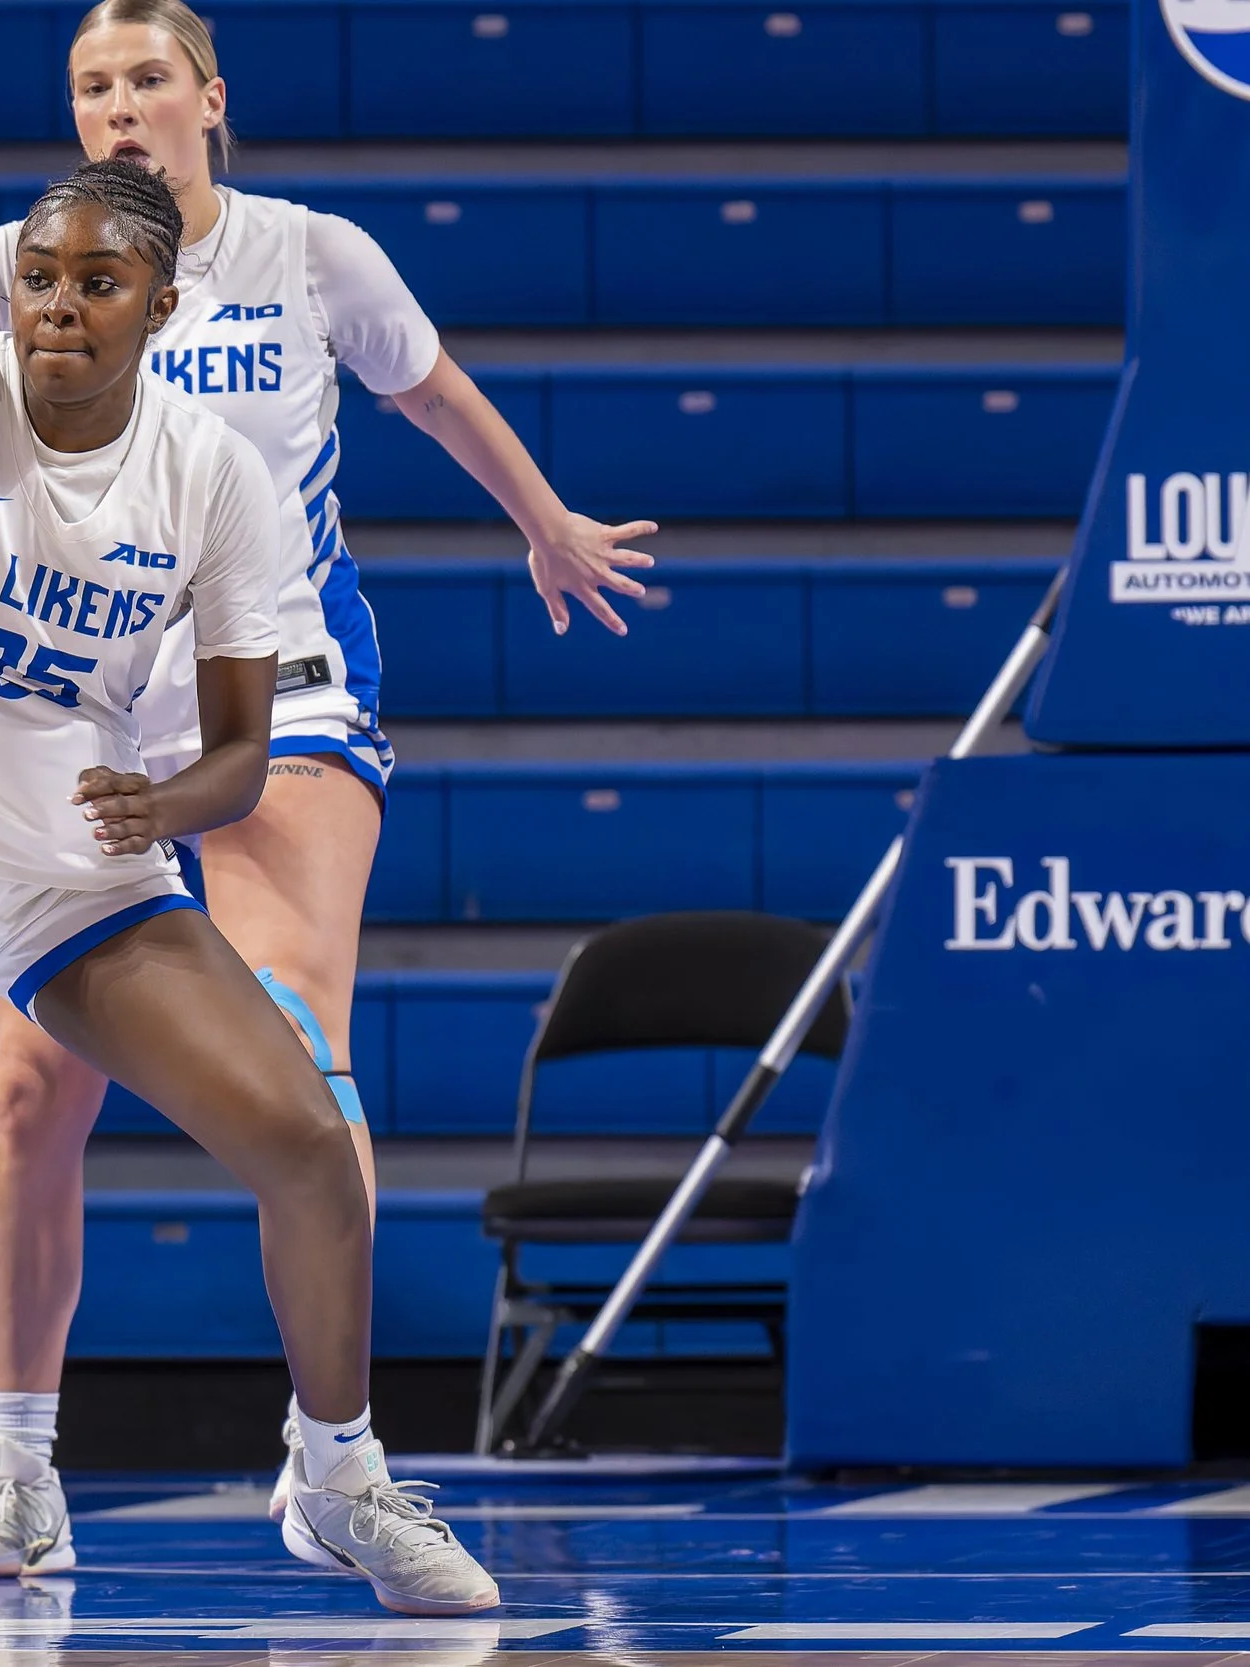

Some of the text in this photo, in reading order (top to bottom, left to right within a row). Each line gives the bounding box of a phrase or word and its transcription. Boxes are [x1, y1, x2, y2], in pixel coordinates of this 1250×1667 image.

[207, 303, 283, 322] A10
[99, 540, 177, 570] A10
[943, 856, 1250, 951] Edwar
